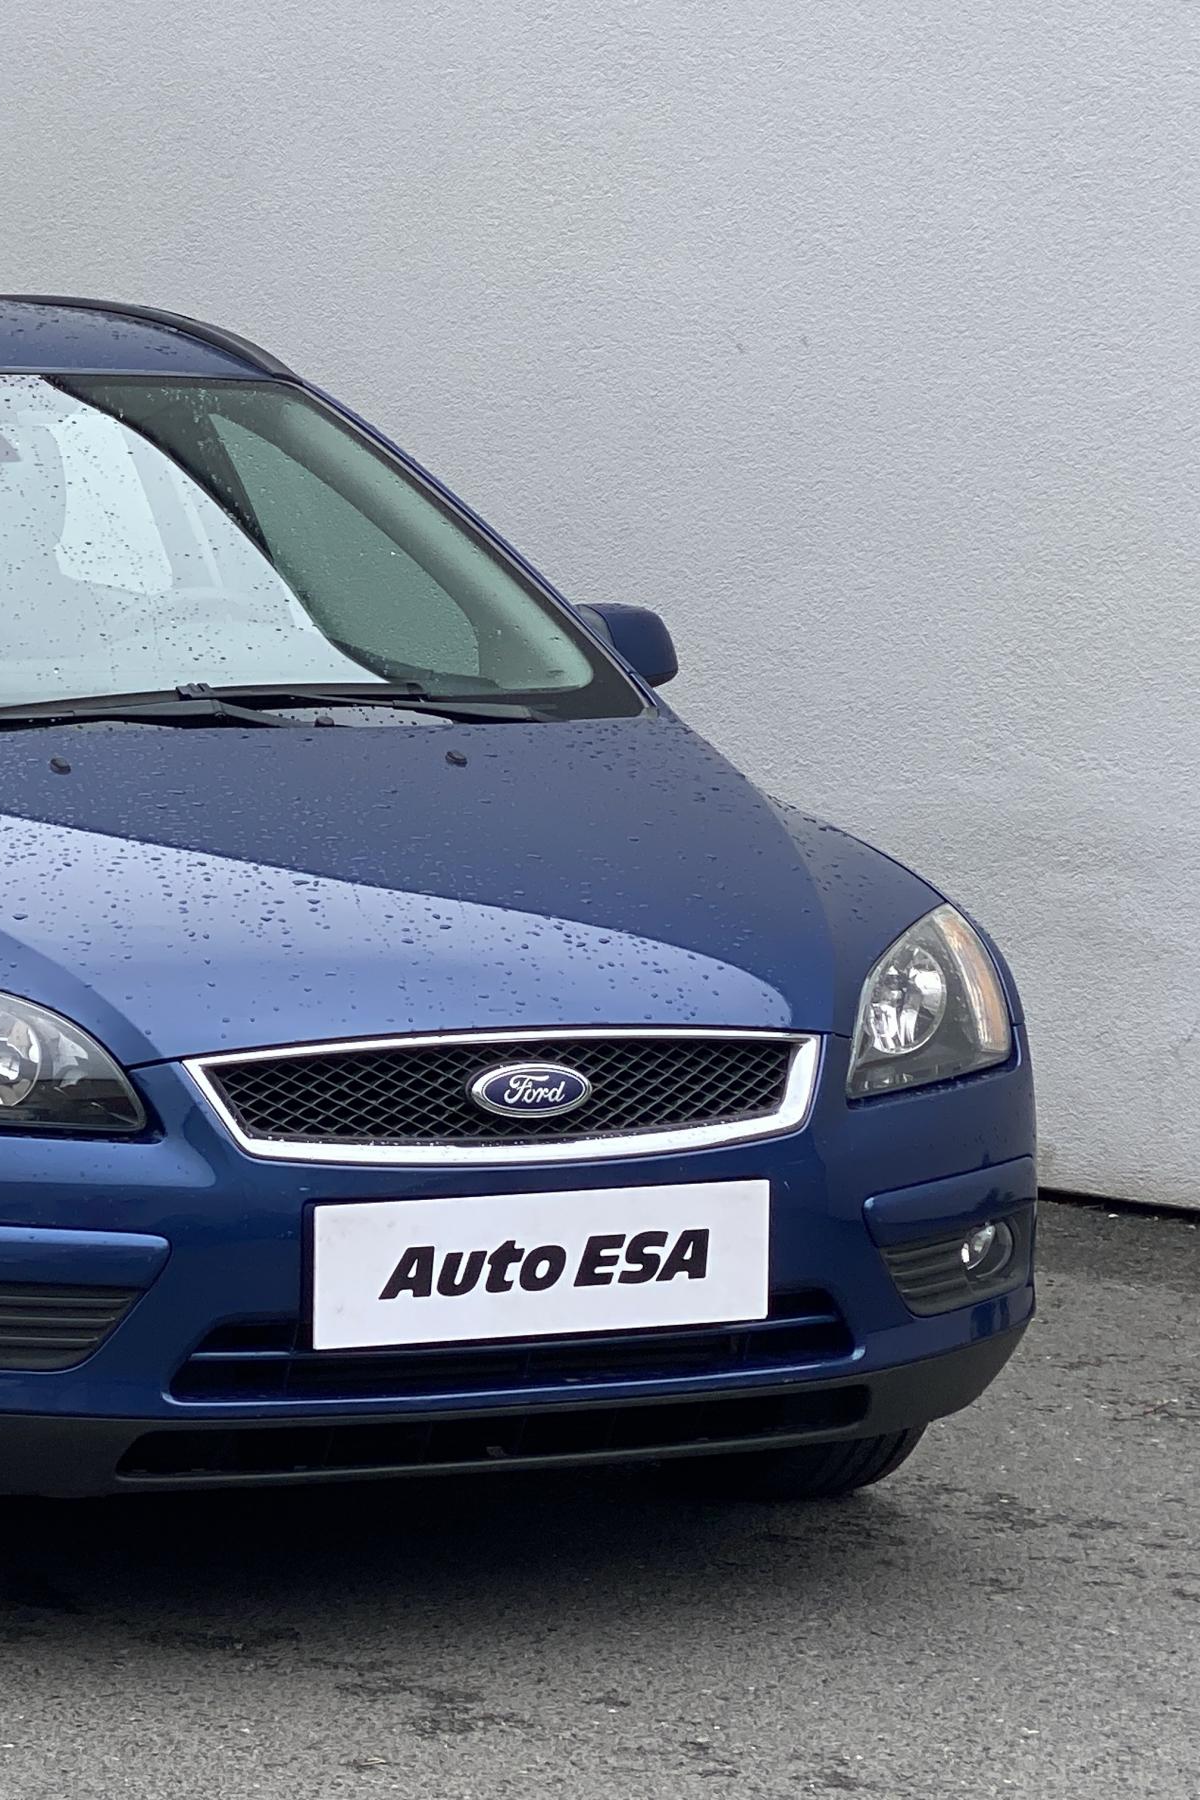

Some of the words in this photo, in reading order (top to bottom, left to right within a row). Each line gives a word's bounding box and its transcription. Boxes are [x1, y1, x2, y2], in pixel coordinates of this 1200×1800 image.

[503, 1074, 566, 1104] Ford
[378, 1239, 567, 1300] Auto
[573, 1228, 709, 1287] ESA
